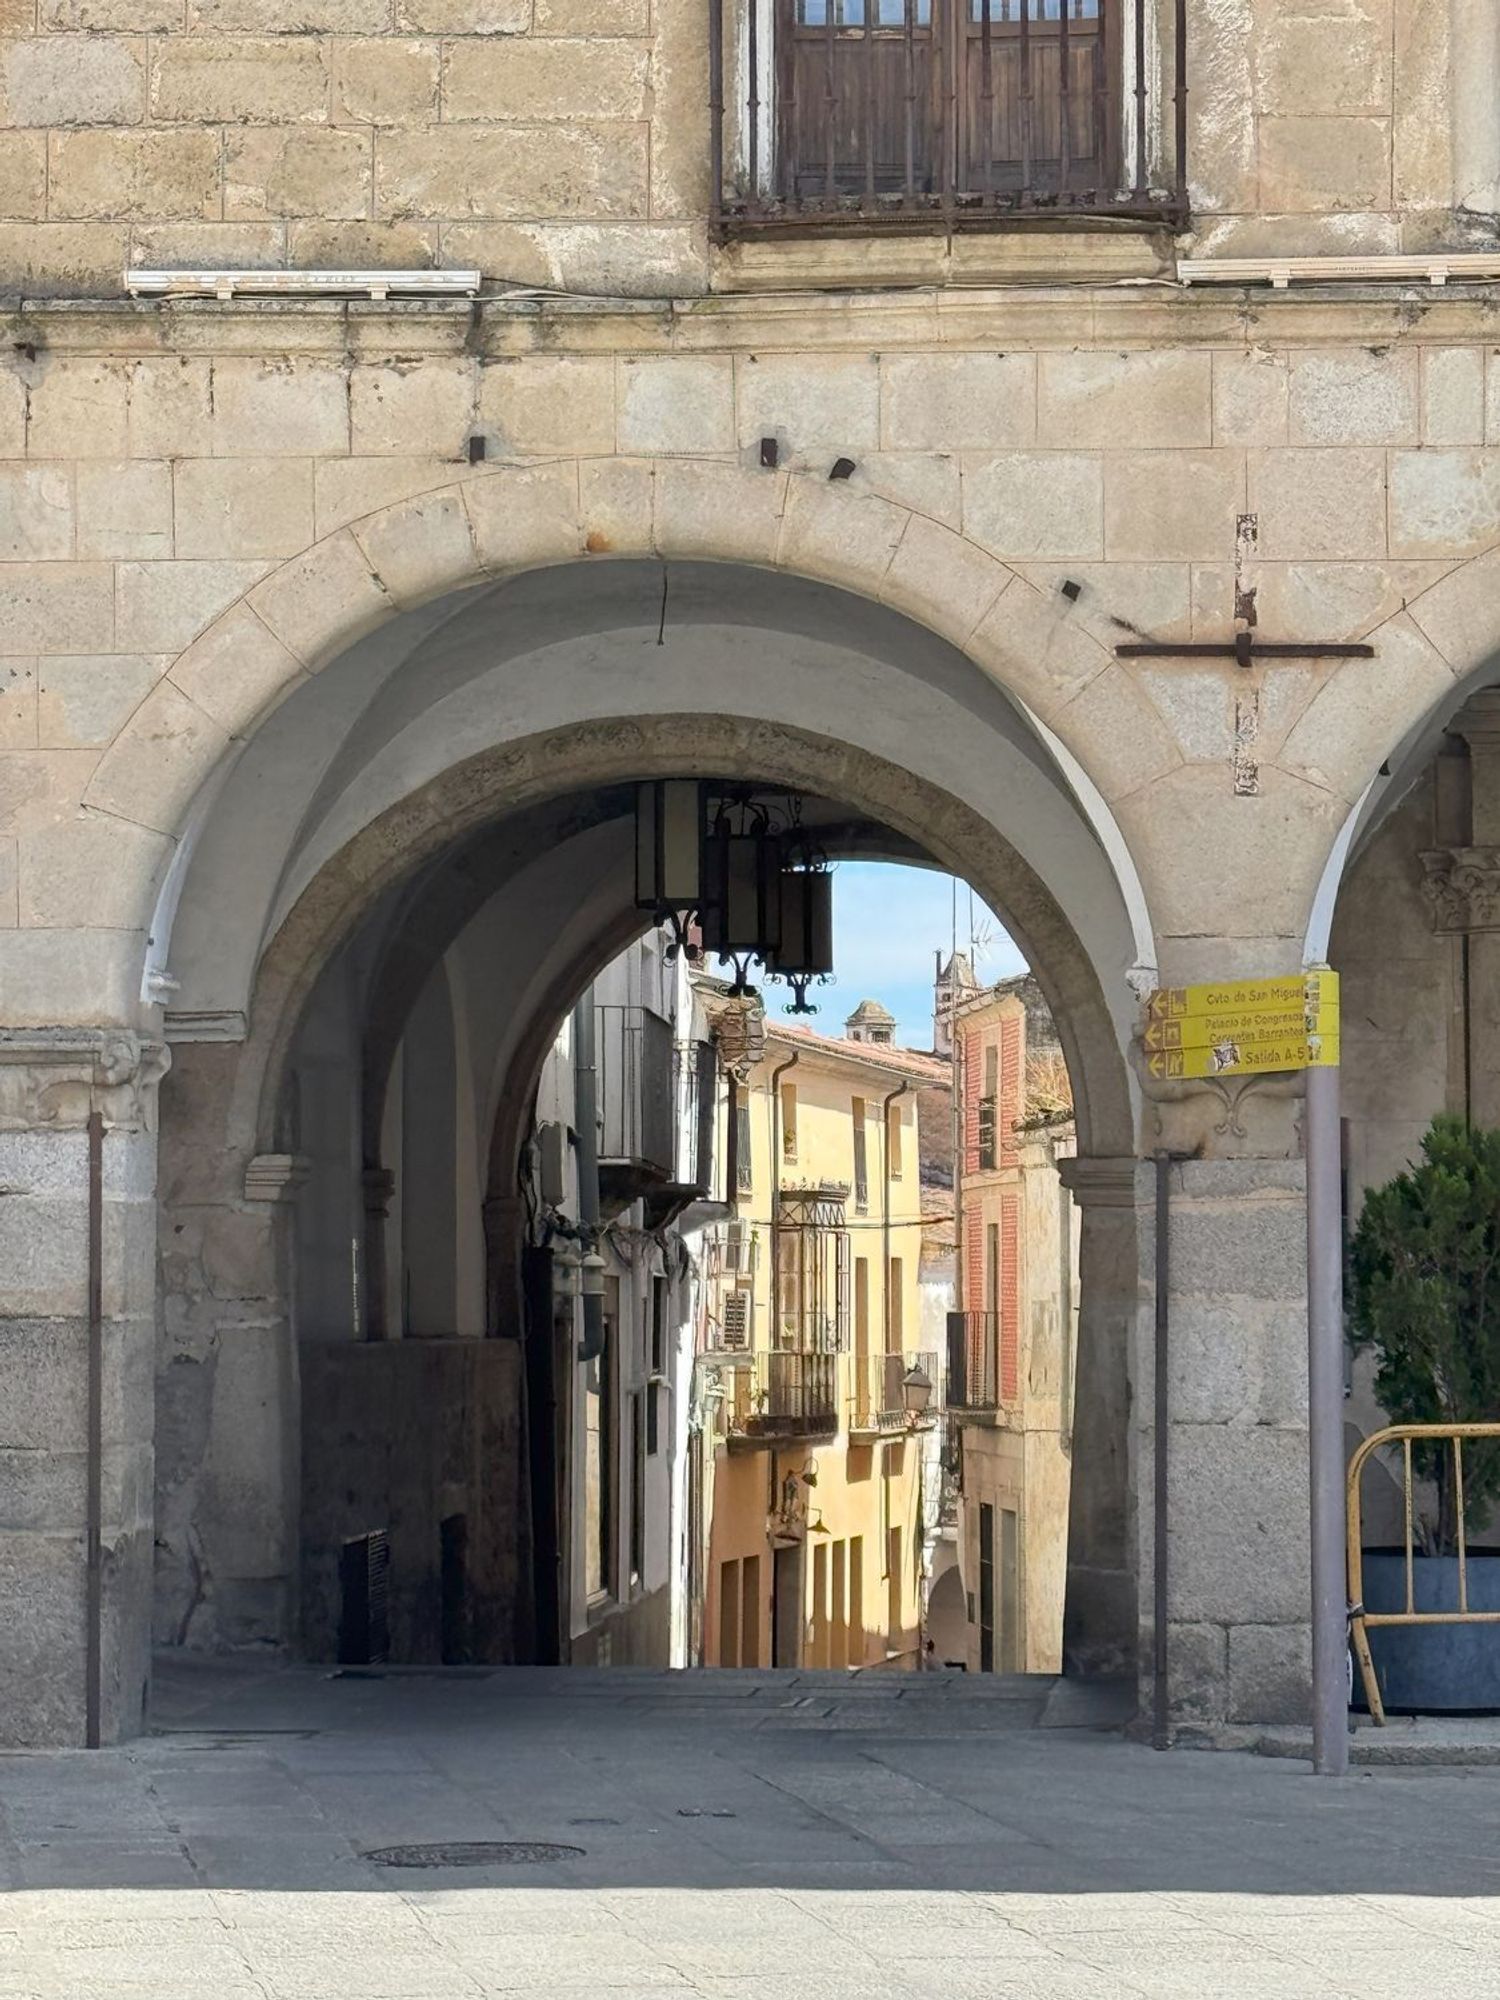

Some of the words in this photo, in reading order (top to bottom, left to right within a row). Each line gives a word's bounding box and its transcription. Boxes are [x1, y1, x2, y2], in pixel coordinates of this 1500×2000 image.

[1234, 990, 1246, 1002] de
[1249, 989, 1268, 1001] San
[1271, 985, 1304, 1001] Miguel
[1205, 1017, 1239, 1029] Palacio
[1241, 1014, 1253, 1027] de
[1255, 1012, 1304, 1025] Congresos
[1246, 1049, 1280, 1064] Salida
[1285, 1046, 1305, 1061] A-5
